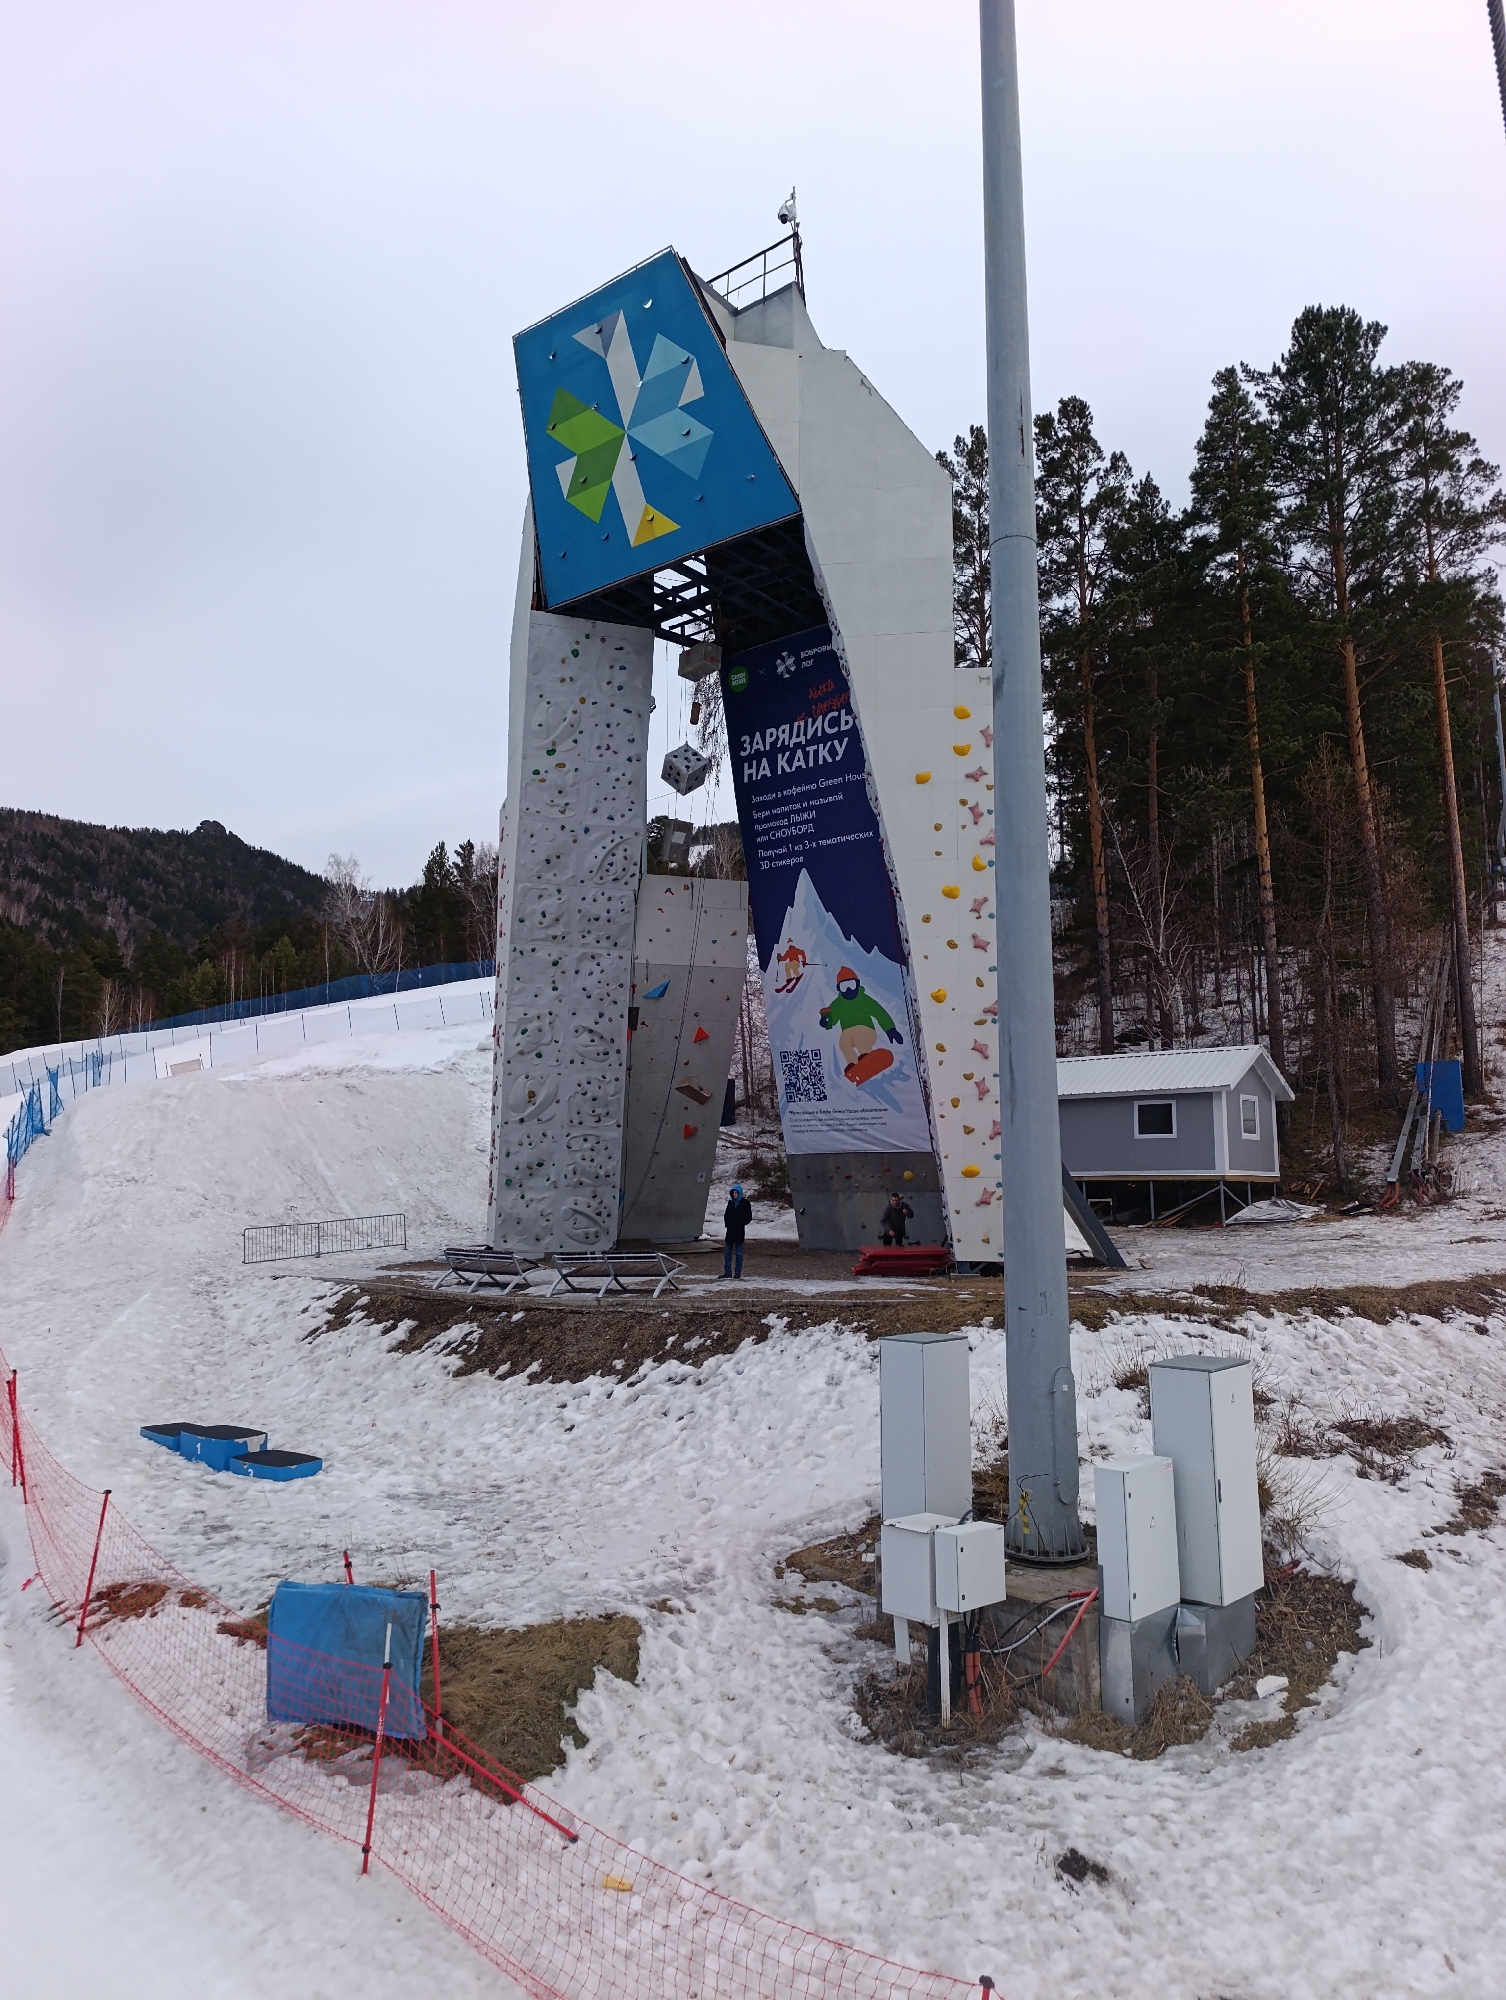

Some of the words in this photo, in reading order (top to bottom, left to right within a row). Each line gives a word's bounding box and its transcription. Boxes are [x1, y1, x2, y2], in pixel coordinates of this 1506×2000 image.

[800, 644, 832, 658] БОБРОВЫ
[801, 658, 815, 669] ЛОГ
[739, 708, 854, 757] ЗАРЯДИСЬ
[743, 757, 772, 783] НА
[777, 737, 849, 775] КАТКУ
[751, 792, 777, 804] Заходи
[783, 782, 817, 797] кофейню
[818, 777, 843, 788] Green
[845, 772, 866, 783] Hous
[752, 809, 771, 820] Бери
[772, 802, 802, 816] напиток
[809, 792, 844, 807] называй
[754, 818, 789, 833] промокод
[790, 809, 816, 824] ЛЫЖИ
[756, 835, 769, 843] или
[769, 823, 815, 841] СНОУБОРД
[758, 845, 788, 858] Получай
[788, 843, 793, 852] 1
[794, 844, 803, 852] из
[804, 840, 817, 850] 3-х
[818, 830, 874, 847] тематических
[759, 860, 770, 870] 3D
[771, 855, 804, 868] стикеров
[196, 1442, 201, 1454] 1
[248, 1468, 254, 1478] 3
